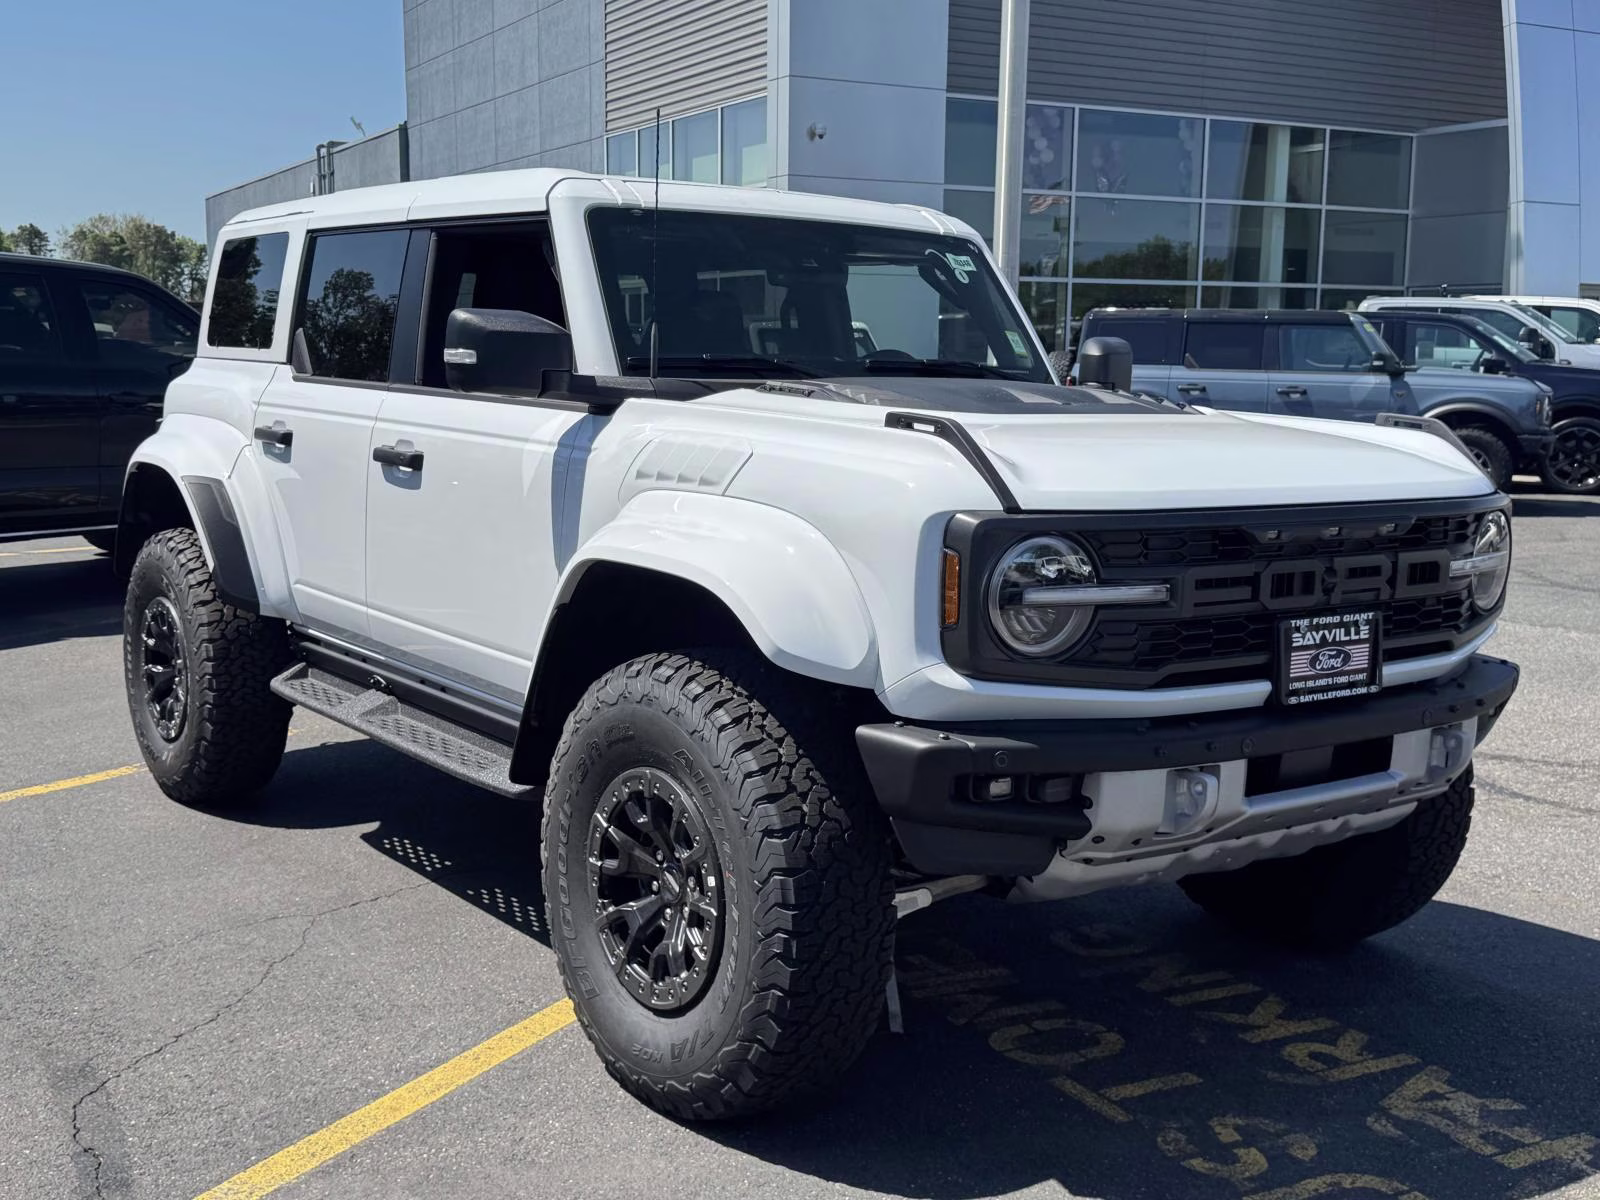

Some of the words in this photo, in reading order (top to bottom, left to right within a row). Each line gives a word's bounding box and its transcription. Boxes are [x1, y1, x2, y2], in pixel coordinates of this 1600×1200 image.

[1184, 549, 1450, 616] FORD
[1291, 618, 1309, 627] THE
[1312, 616, 1340, 625] FORD
[1343, 612, 1374, 622] GIANT
[1291, 625, 1370, 647] SAYVILLE
[1315, 650, 1344, 670] Ford
[1289, 681, 1305, 690] LONG
[1334, 676, 1348, 685] FORD
[1349, 673, 1367, 682] GIANT
[1300, 687, 1368, 702] SAYVILLEFORD.COM
